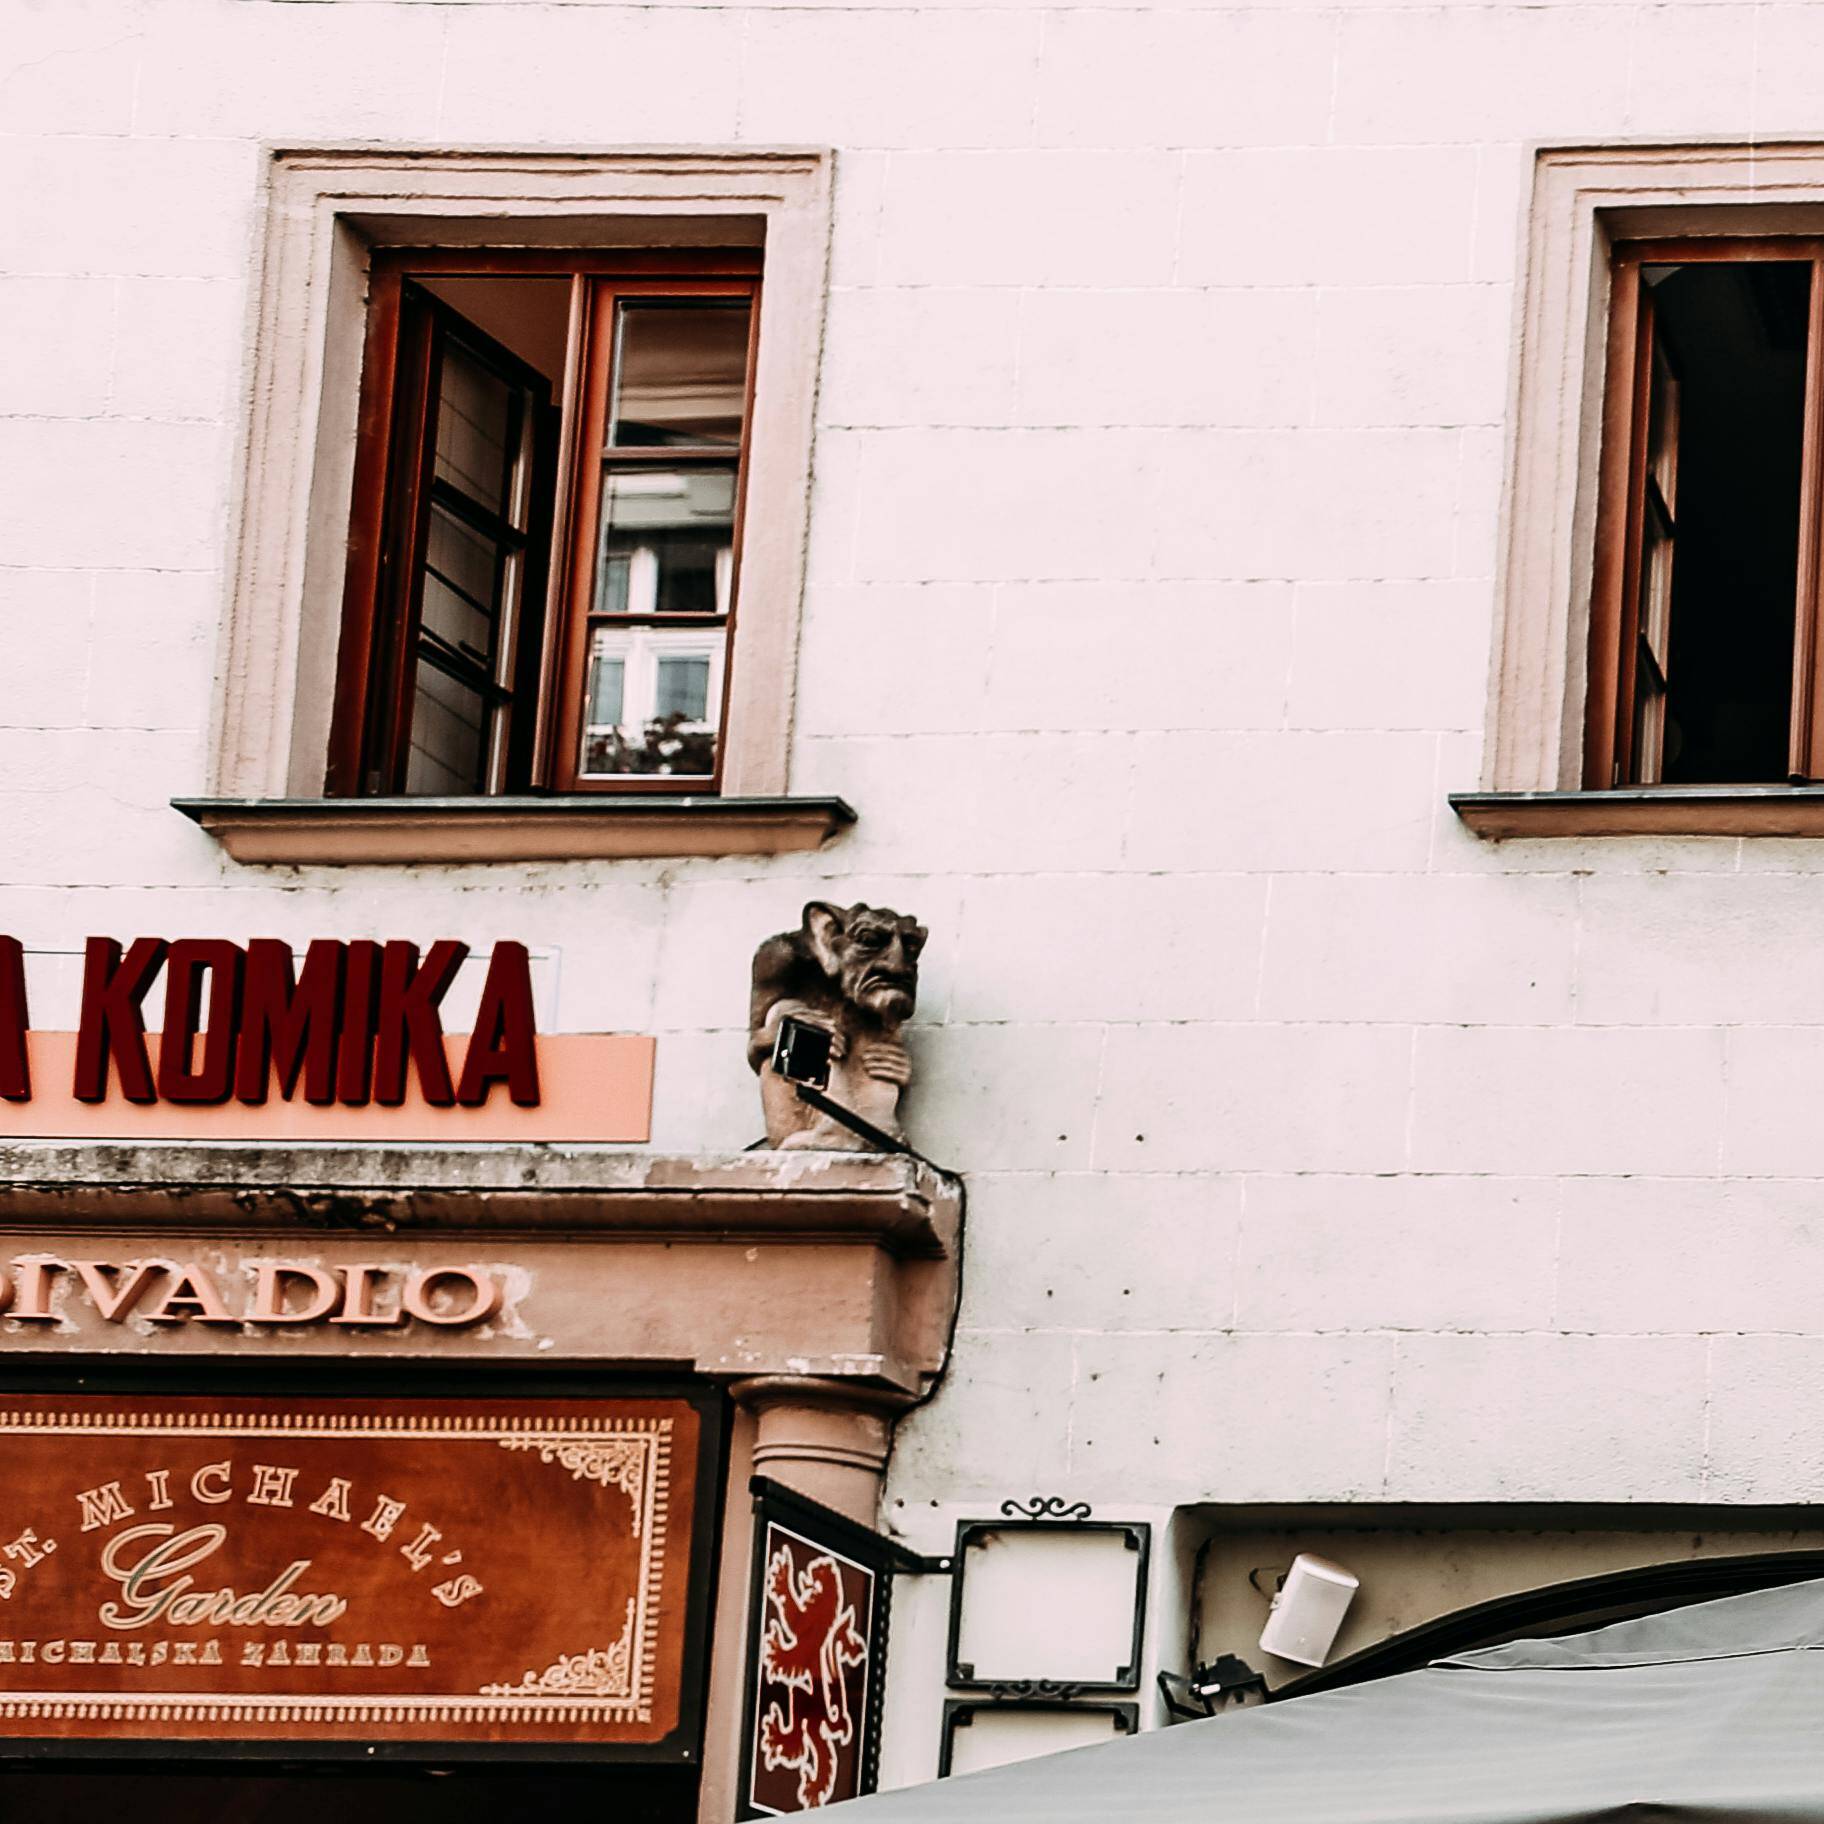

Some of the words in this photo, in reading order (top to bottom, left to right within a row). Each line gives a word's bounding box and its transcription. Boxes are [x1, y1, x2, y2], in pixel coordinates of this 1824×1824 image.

[73, 937, 540, 1106] KOMIKA
[0, 1257, 500, 1326] IVADLO
[75, 1460, 483, 1607] MICHAEL'S
[99, 1523, 347, 1630] Garden
